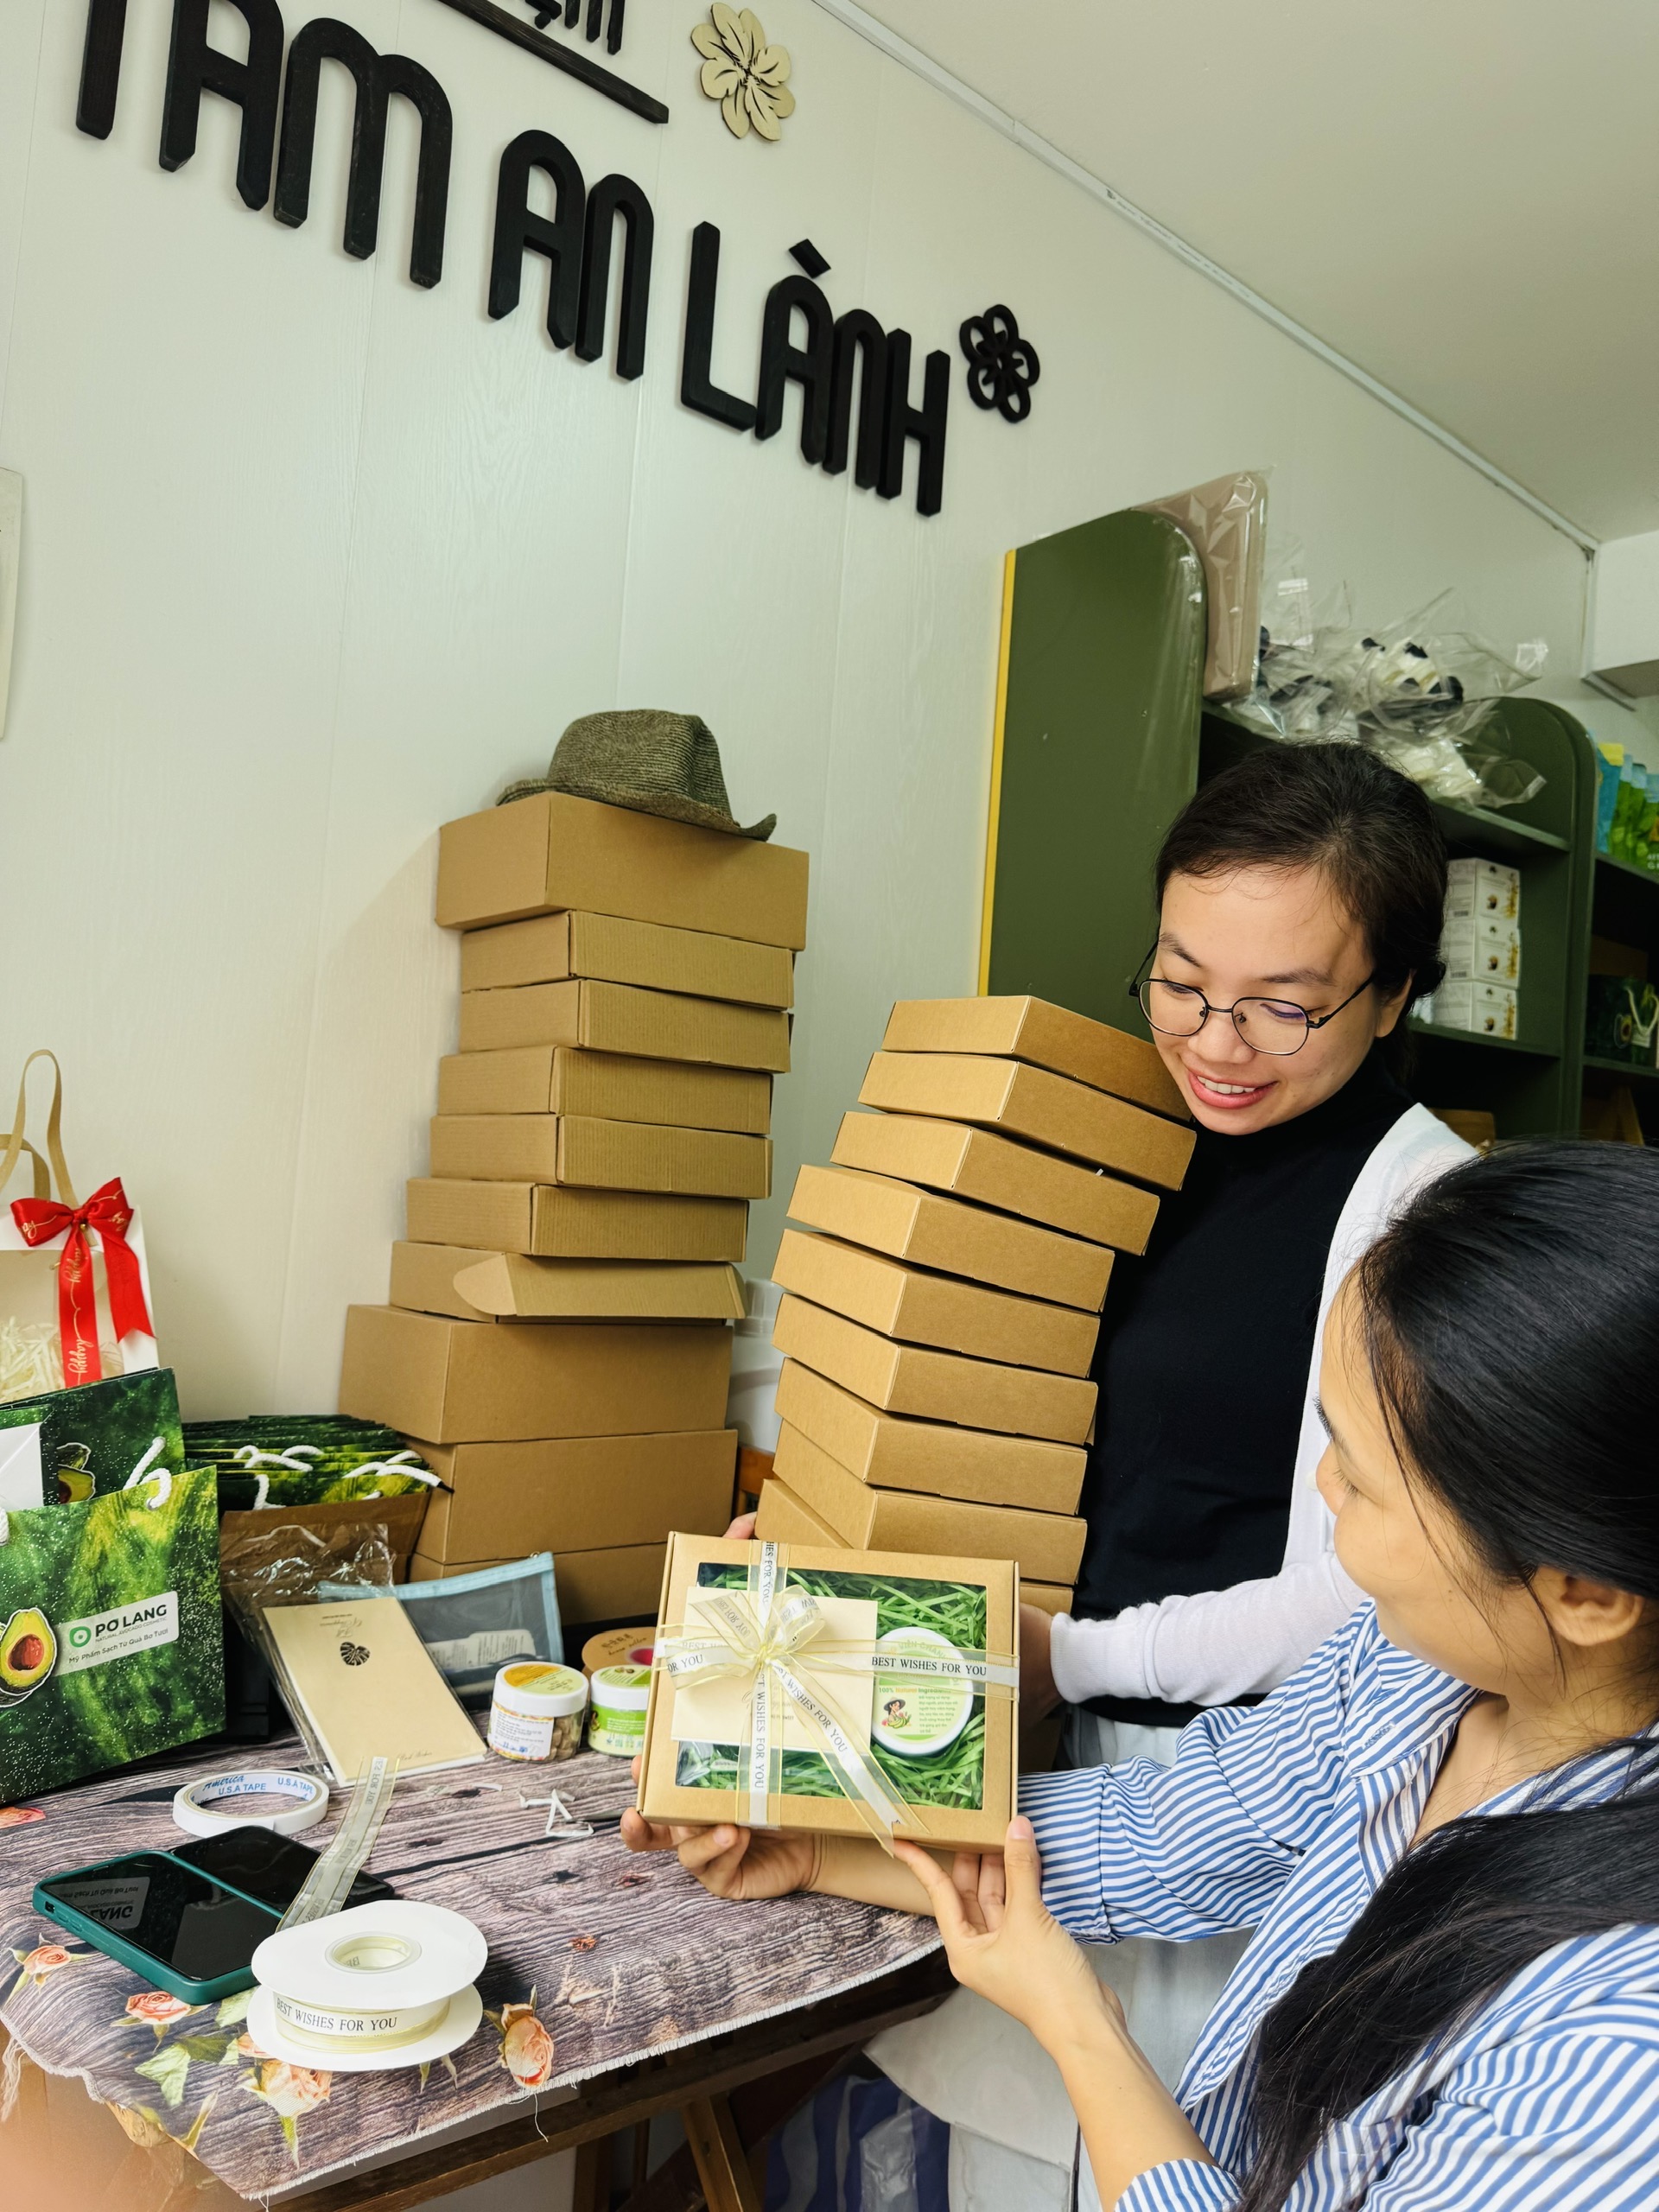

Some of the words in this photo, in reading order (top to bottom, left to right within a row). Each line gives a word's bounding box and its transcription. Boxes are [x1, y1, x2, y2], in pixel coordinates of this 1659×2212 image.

[488, 130, 654, 381] AN
[681, 220, 950, 517] LÀNH
[763, 1560, 773, 1579] FOR
[123, 1605, 167, 1628] LANG
[667, 1662, 679, 1673] OR
[681, 1655, 703, 1668] YOU
[872, 1656, 896, 1668] BEST
[900, 1658, 938, 1671] WISHES
[942, 1662, 961, 1674] FOR
[965, 1665, 987, 1676] YOU
[756, 1691, 766, 1732] WISHES
[787, 1678, 816, 1712] WISHES
[814, 1709, 831, 1729] FOR
[830, 1729, 849, 1753] YOU
[756, 1738, 766, 1759] FOR
[244, 1783, 266, 1791] TAPE
[299, 1780, 313, 1794] TAPE
[754, 1764, 766, 1789] YOU
[276, 1998, 292, 2017] BEST
[295, 2009, 334, 2030] WISHES
[340, 2019, 364, 2031] FOR
[370, 2017, 397, 2031] YOU
